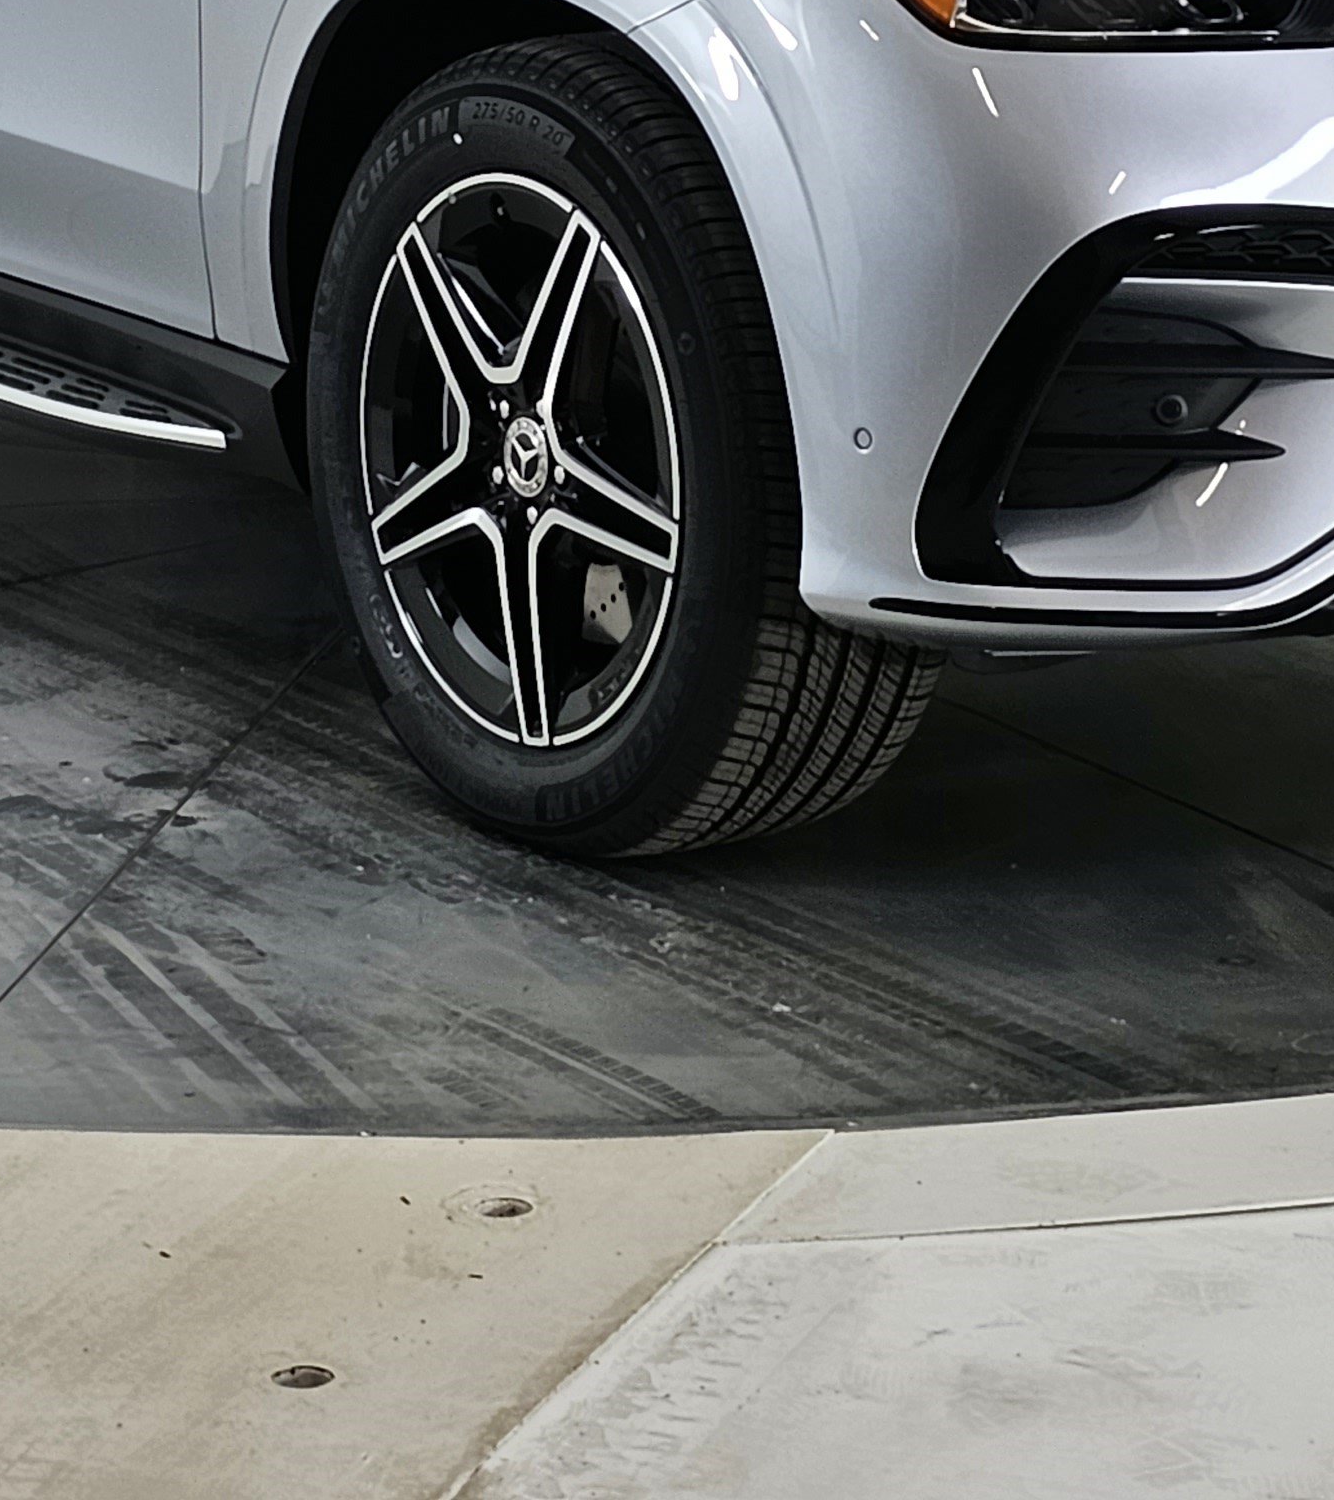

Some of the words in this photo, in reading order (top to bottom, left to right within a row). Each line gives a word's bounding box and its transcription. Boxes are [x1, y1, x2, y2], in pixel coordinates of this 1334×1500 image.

[471, 102, 526, 127] 275/50
[529, 117, 540, 132] R
[542, 126, 564, 147] 20
